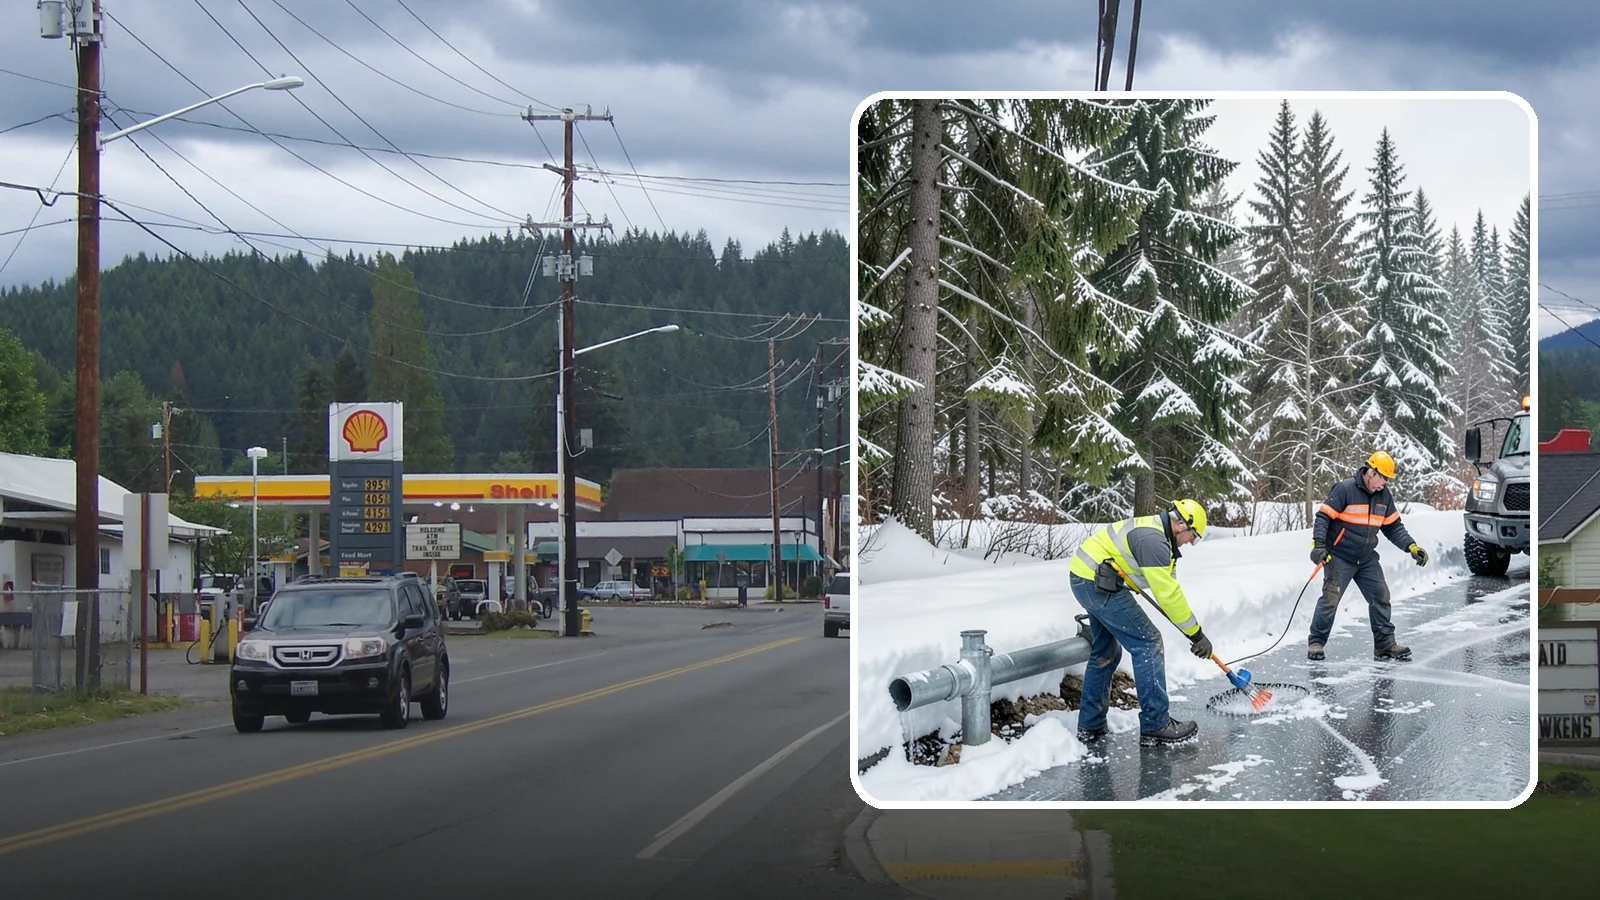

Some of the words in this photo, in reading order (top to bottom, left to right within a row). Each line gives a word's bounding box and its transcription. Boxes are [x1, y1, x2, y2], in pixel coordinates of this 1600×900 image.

[365, 480, 384, 490] 395
[490, 484, 547, 499] Shell
[365, 494, 384, 504] 405
[365, 508, 384, 518] 415
[365, 522, 384, 532] 429
